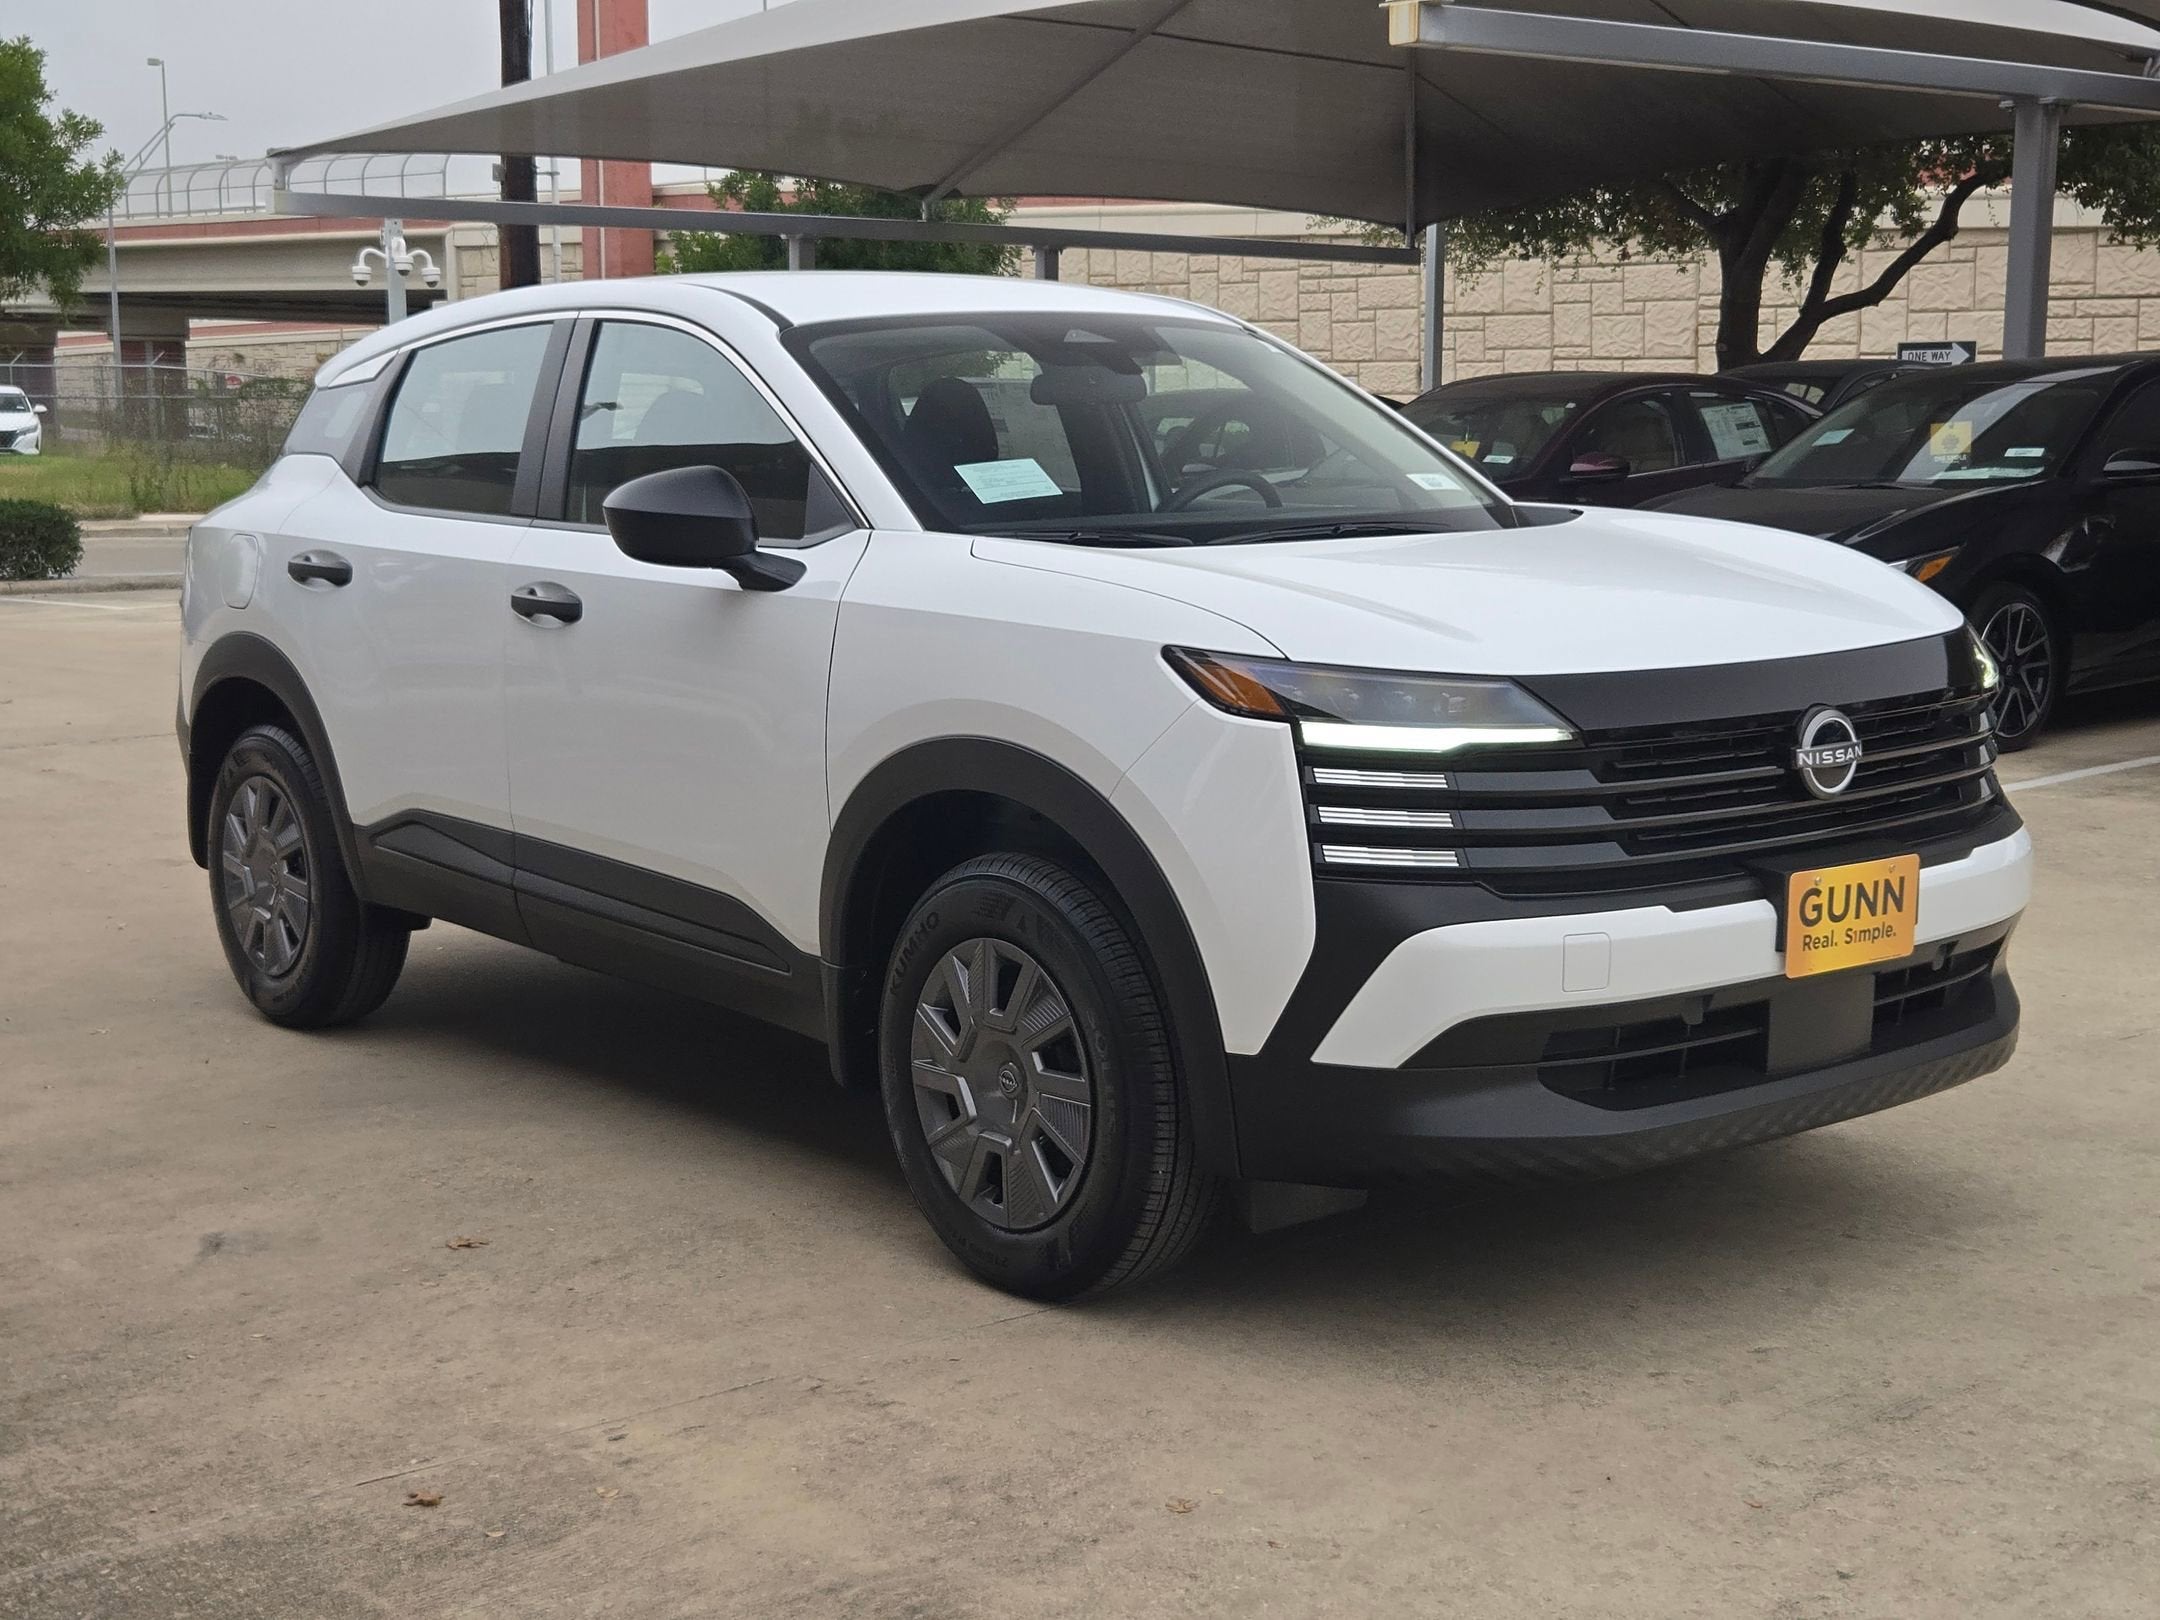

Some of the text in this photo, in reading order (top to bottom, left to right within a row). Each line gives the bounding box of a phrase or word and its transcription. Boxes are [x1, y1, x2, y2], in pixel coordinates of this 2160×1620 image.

[1907, 351, 1951, 361] ONE WAY
[1799, 745, 1862, 766] NISSAN
[1799, 875, 1905, 928] GUNN
[1802, 930, 1838, 952] Real.
[890, 911, 940, 996] KUMHO
